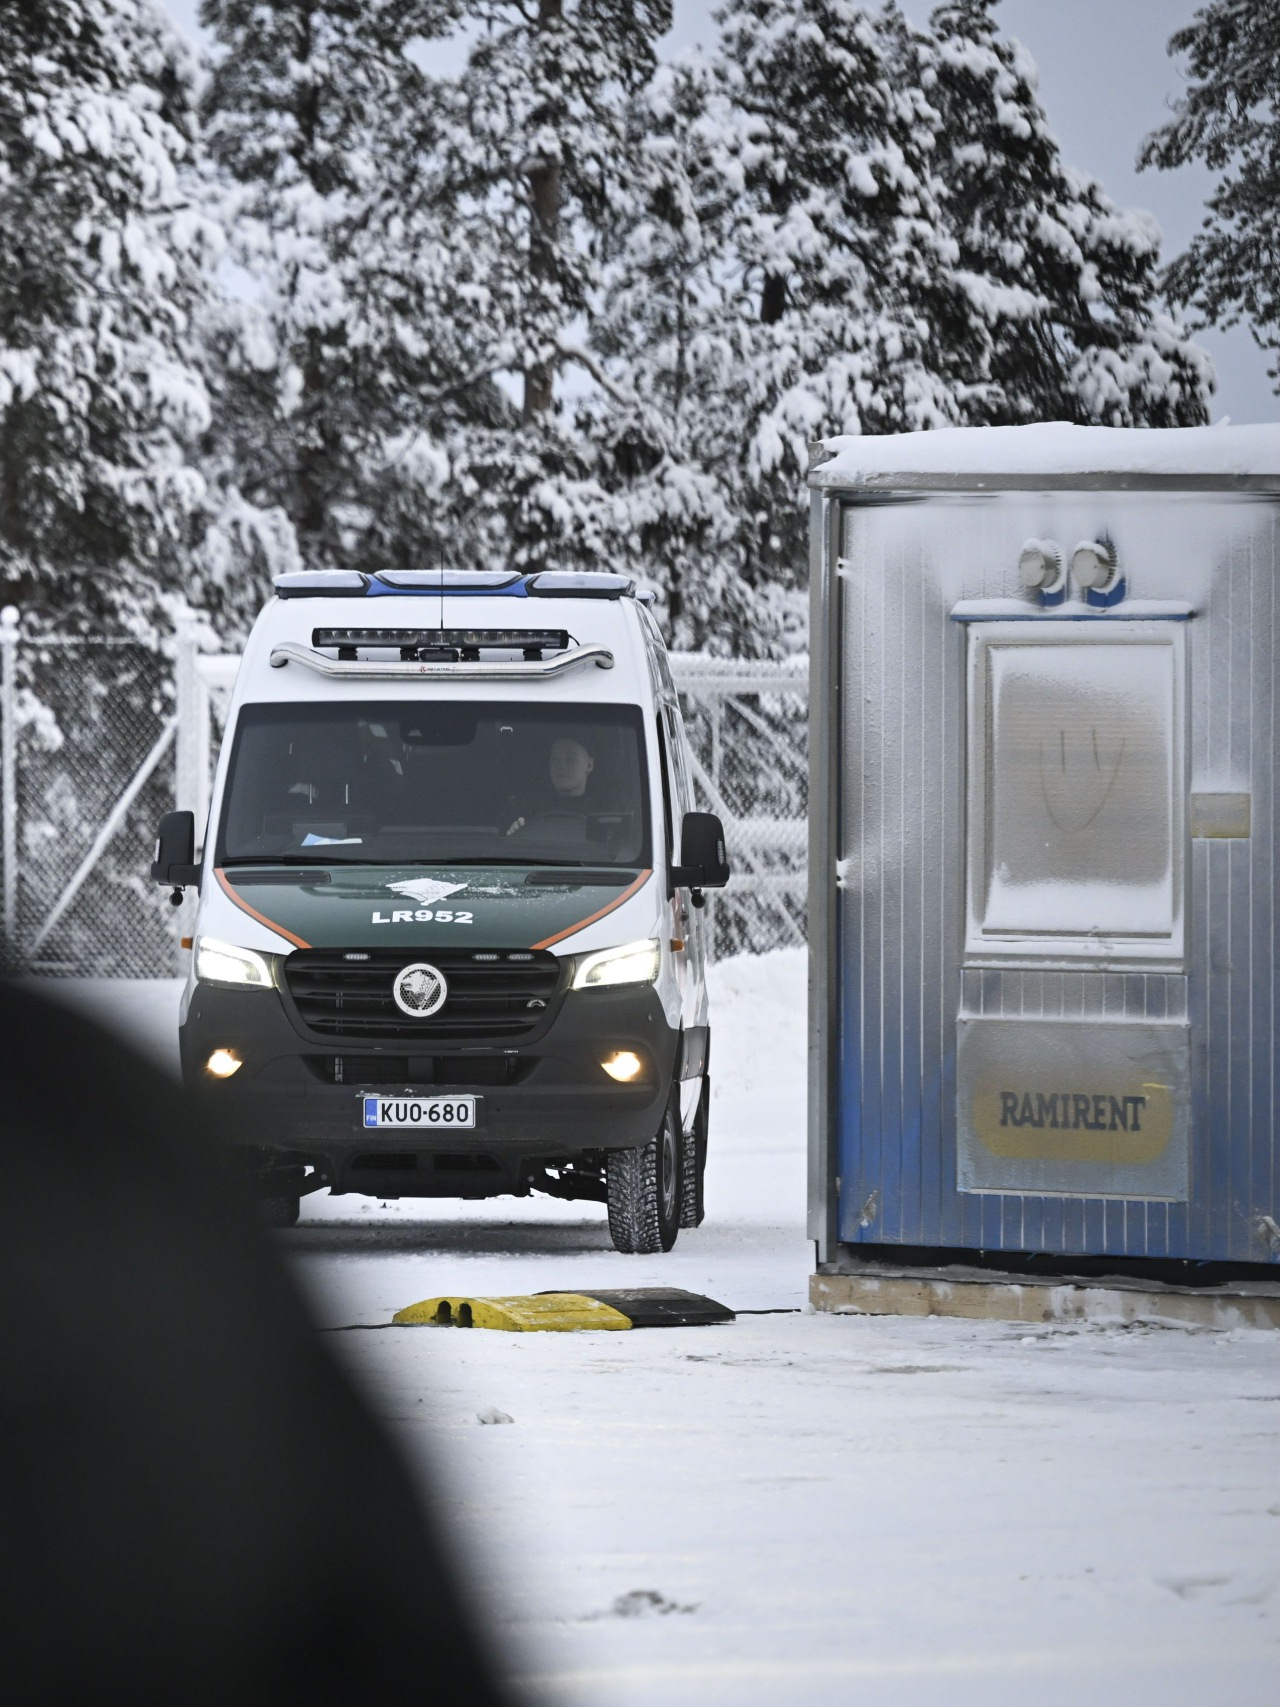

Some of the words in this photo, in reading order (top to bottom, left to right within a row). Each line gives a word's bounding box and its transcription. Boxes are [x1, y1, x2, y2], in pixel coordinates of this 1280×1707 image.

[372, 910, 474, 924] LR952
[381, 1103, 469, 1122] KUO-680
[999, 1091, 1147, 1132] RAMIRENT
